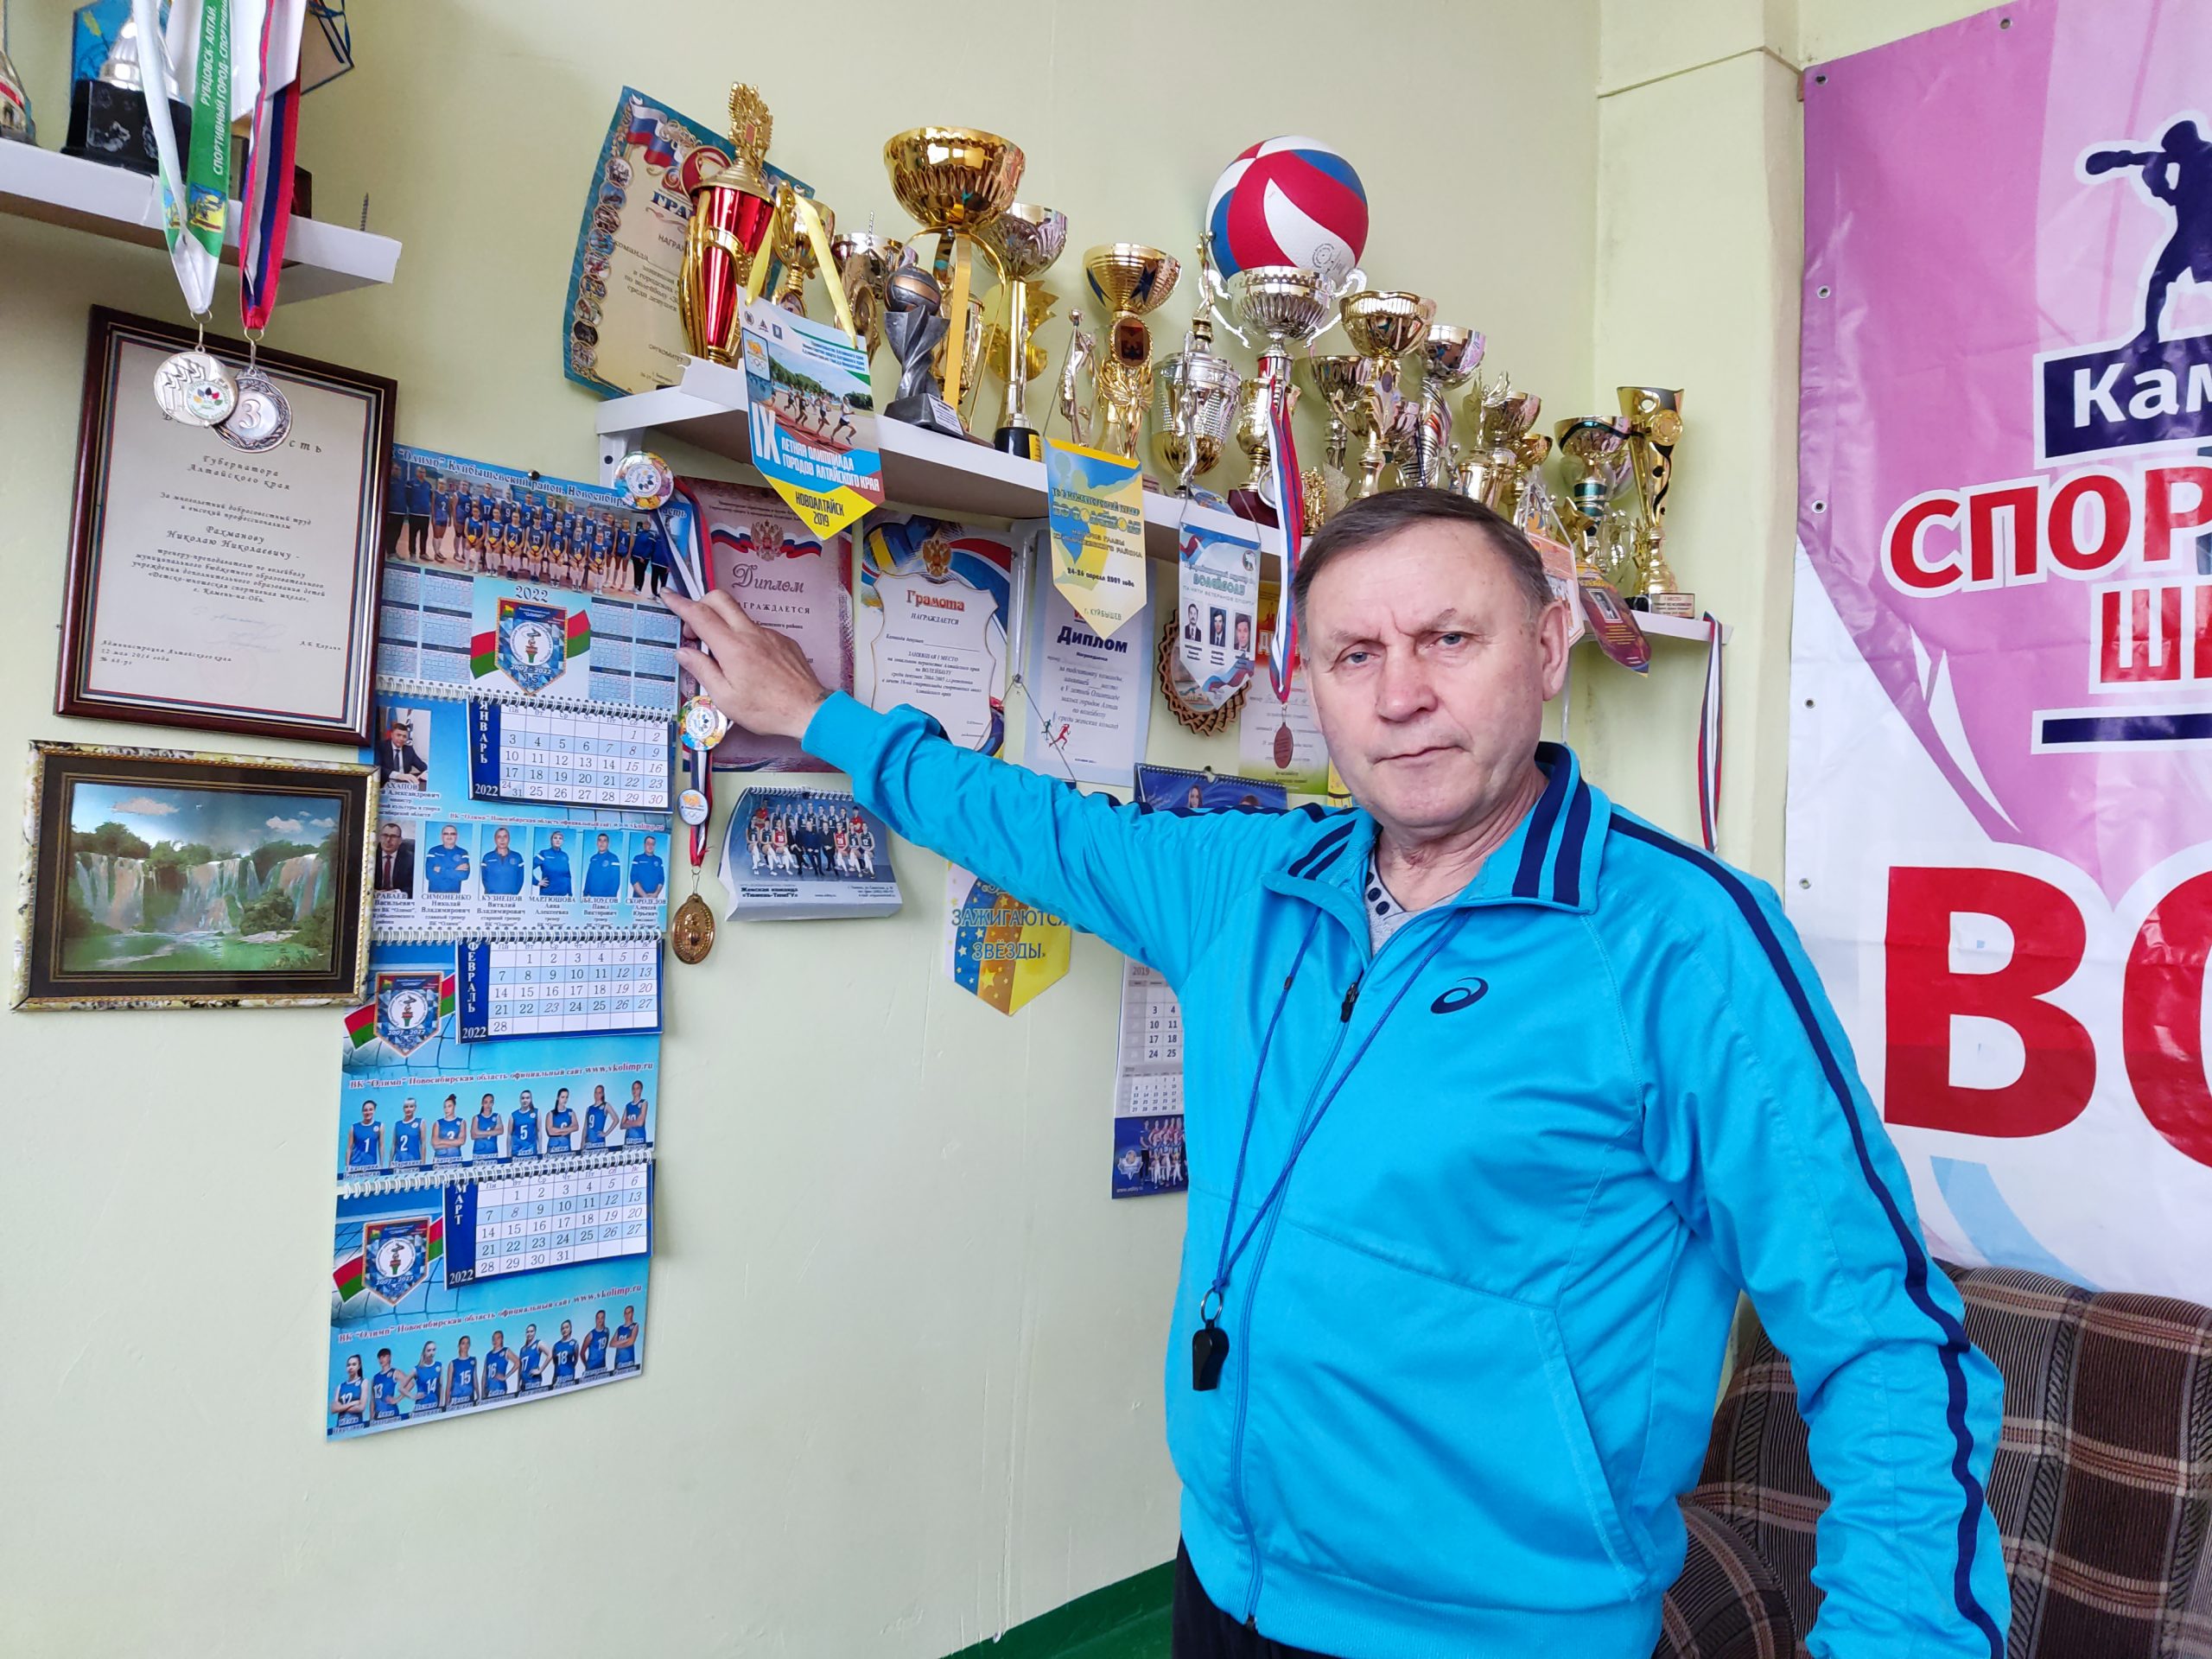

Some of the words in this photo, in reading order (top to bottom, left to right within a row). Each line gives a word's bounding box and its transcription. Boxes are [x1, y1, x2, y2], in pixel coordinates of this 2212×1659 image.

[239, 399, 261, 429] 3
[752, 402, 781, 465] IX
[781, 437, 807, 454] ЛЕТНЯЯ
[808, 447, 855, 471] ОЛИМПИАДА
[783, 454, 814, 475] ГОРОДОВ
[816, 464, 860, 486] АЛТАЙСКОГО
[861, 476, 880, 492] КРАЯ
[795, 492, 844, 516] НОВОАЛТАЙСК
[813, 512, 830, 526] 2019
[1891, 465, 2212, 589] СПОР
[167, 531, 217, 545] Николаю
[732, 563, 804, 594] Диплом
[516, 585, 549, 603] 2022
[906, 589, 965, 612] Грамота
[912, 613, 959, 625] НАГРАЖДАЕТСЯ
[1090, 608, 1122, 620] КУЙБЫШЕВ
[1057, 626, 1128, 653] Диплом
[524, 674, 539, 683] 15
[480, 701, 489, 764] ЯНВАРЬ
[654, 733, 660, 741] 2
[510, 734, 516, 744] 3
[535, 737, 541, 747] 4
[559, 740, 565, 748] 5
[583, 742, 589, 751] 6
[607, 744, 613, 753] 7
[629, 746, 635, 755] 8
[652, 748, 659, 757] 9
[505, 751, 518, 760] 10
[532, 753, 543, 763] 11
[556, 756, 569, 766] 12
[580, 758, 592, 767] 13
[603, 760, 615, 769] 14
[626, 761, 639, 771] 15
[650, 764, 663, 772] 16
[505, 767, 518, 778] 17
[531, 770, 543, 779] 18
[556, 772, 568, 781] 19
[579, 774, 592, 783] 20
[604, 776, 615, 785] 21
[626, 778, 639, 787] 22
[650, 779, 663, 788] 23
[475, 784, 499, 796] 2022
[530, 786, 543, 796] 25
[555, 788, 567, 798] 26
[578, 790, 591, 799] 27
[602, 791, 614, 801] 28
[626, 793, 639, 803] 29
[649, 795, 663, 804] 30
[467, 943, 479, 1013] ФЕВРАЛЬ
[499, 971, 505, 981] 7
[1133, 966, 1149, 976] 2019
[495, 988, 507, 998] 14
[521, 987, 534, 997] 15
[546, 986, 559, 996] 16
[571, 986, 583, 995] 17
[594, 985, 606, 995] 18
[616, 984, 629, 993] 19
[639, 982, 652, 993] 20
[495, 1005, 507, 1014] 21
[519, 1004, 533, 1014] 22
[544, 1003, 559, 1013] 23
[569, 1002, 582, 1012] 24
[594, 1001, 606, 1010] 25
[615, 1000, 629, 1009] 26
[638, 999, 652, 1008] 27
[462, 1027, 486, 1039] 2022
[494, 1022, 507, 1032] 28
[1149, 1035, 1159, 1044] 17
[1149, 1050, 1158, 1058] 24
[1167, 1049, 1176, 1058] 25
[409, 1074, 474, 1085] Новосибирская
[454, 1184, 467, 1225] МАРТ
[449, 1270, 474, 1284] 2022
